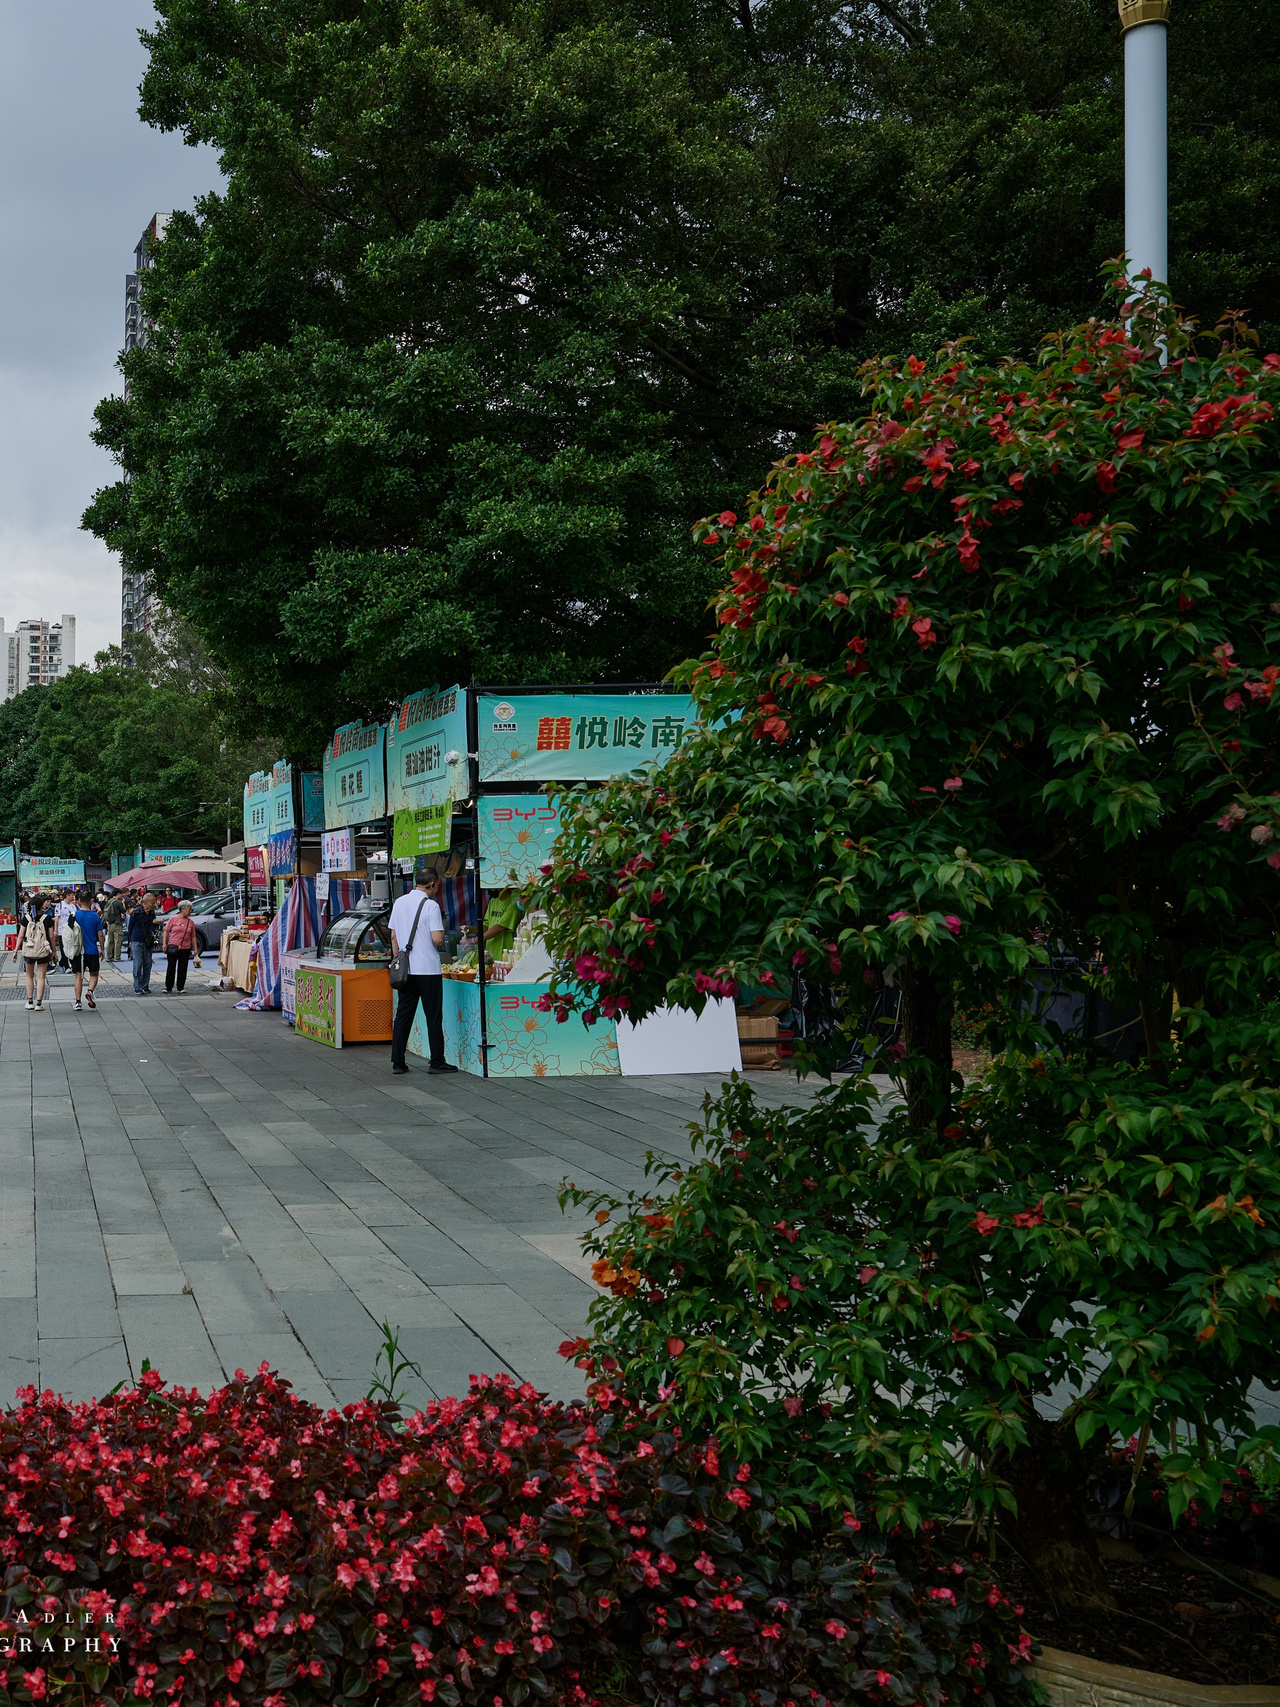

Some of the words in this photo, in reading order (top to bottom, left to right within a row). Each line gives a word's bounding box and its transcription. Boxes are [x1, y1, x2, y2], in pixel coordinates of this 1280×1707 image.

[536, 715, 686, 751] 囍悦岭南
[493, 807, 558, 821] BYD
